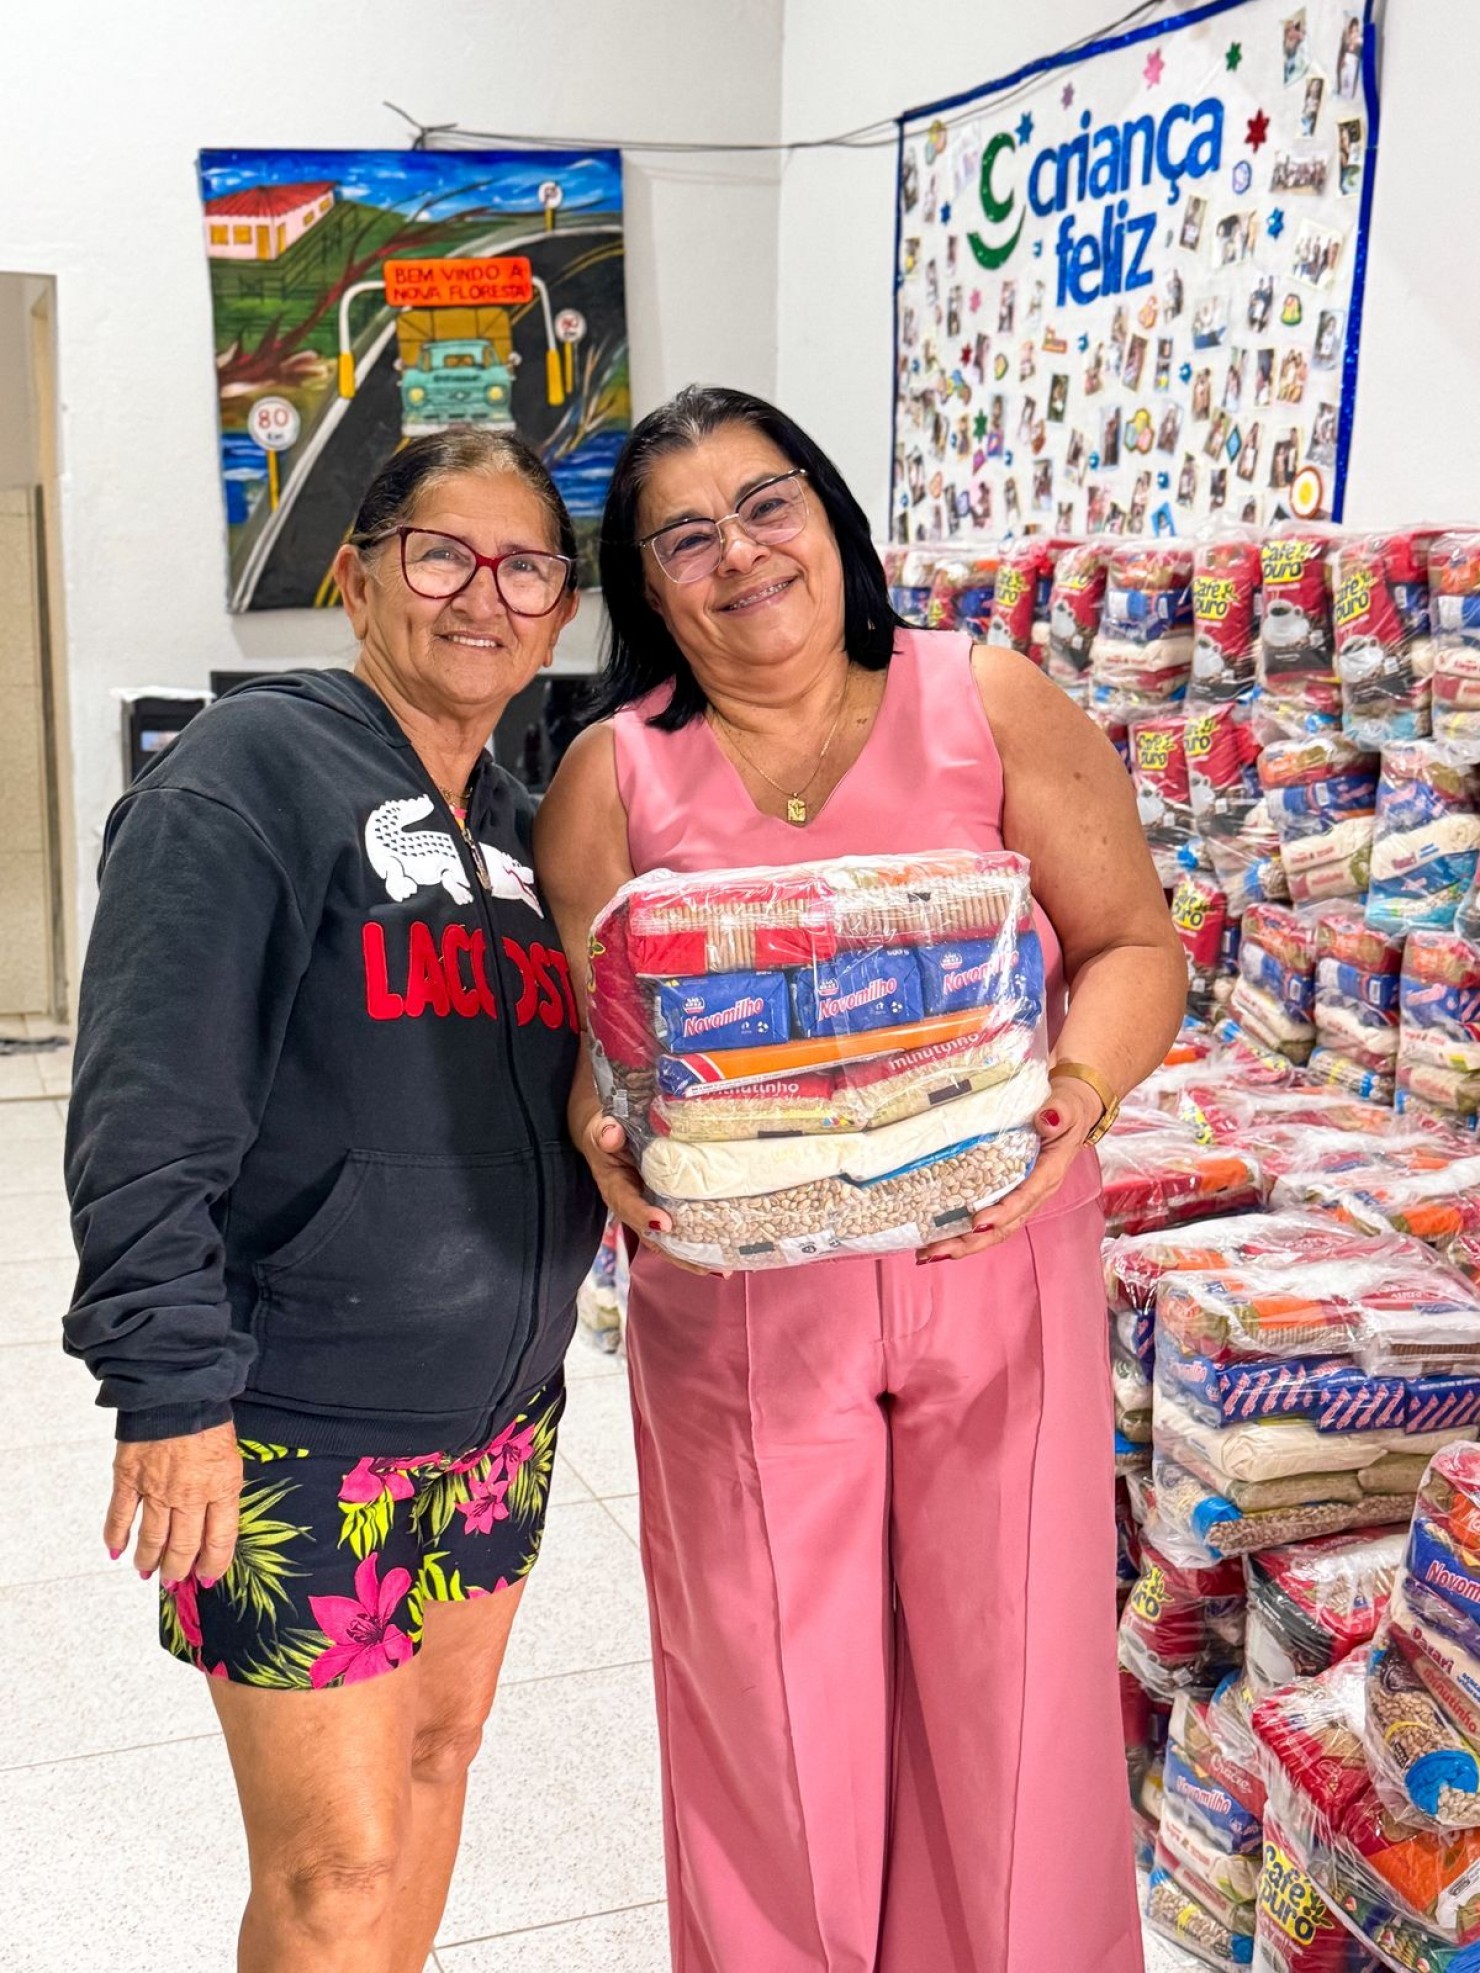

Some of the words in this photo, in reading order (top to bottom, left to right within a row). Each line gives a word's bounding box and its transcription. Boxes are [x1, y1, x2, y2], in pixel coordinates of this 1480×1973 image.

[1027, 97, 1226, 218] criança
[394, 267, 433, 283] BEM
[440, 264, 500, 281] VINDO
[1056, 200, 1158, 307] feliz
[393, 286, 439, 301] NOVA
[449, 285, 525, 300] FLORESTA
[258, 408, 289, 429] 80
[362, 920, 580, 1036] LACOST
[819, 977, 898, 1022] Novomilho
[682, 996, 765, 1038] Novomilho
